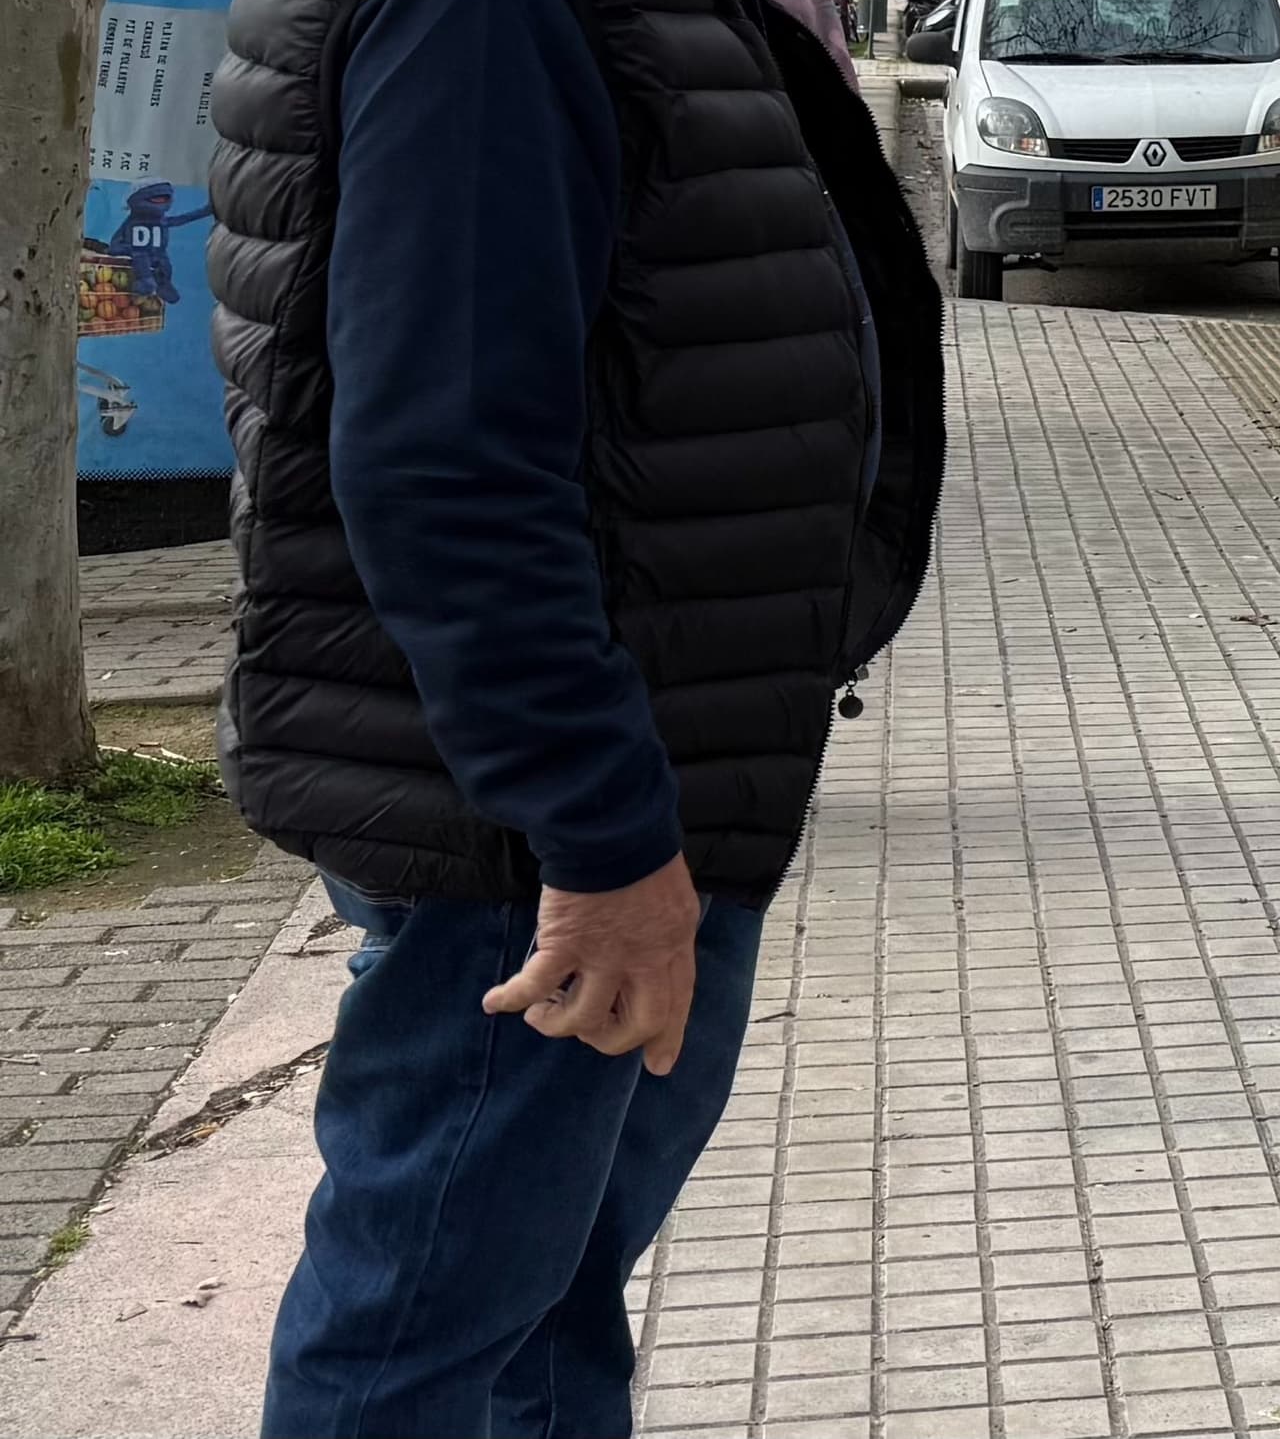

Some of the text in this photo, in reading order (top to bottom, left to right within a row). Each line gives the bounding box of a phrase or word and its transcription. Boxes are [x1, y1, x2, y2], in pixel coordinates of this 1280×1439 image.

[1107, 189, 1163, 208] 2530
[1170, 188, 1212, 207] FVT
[131, 226, 161, 247] DI
